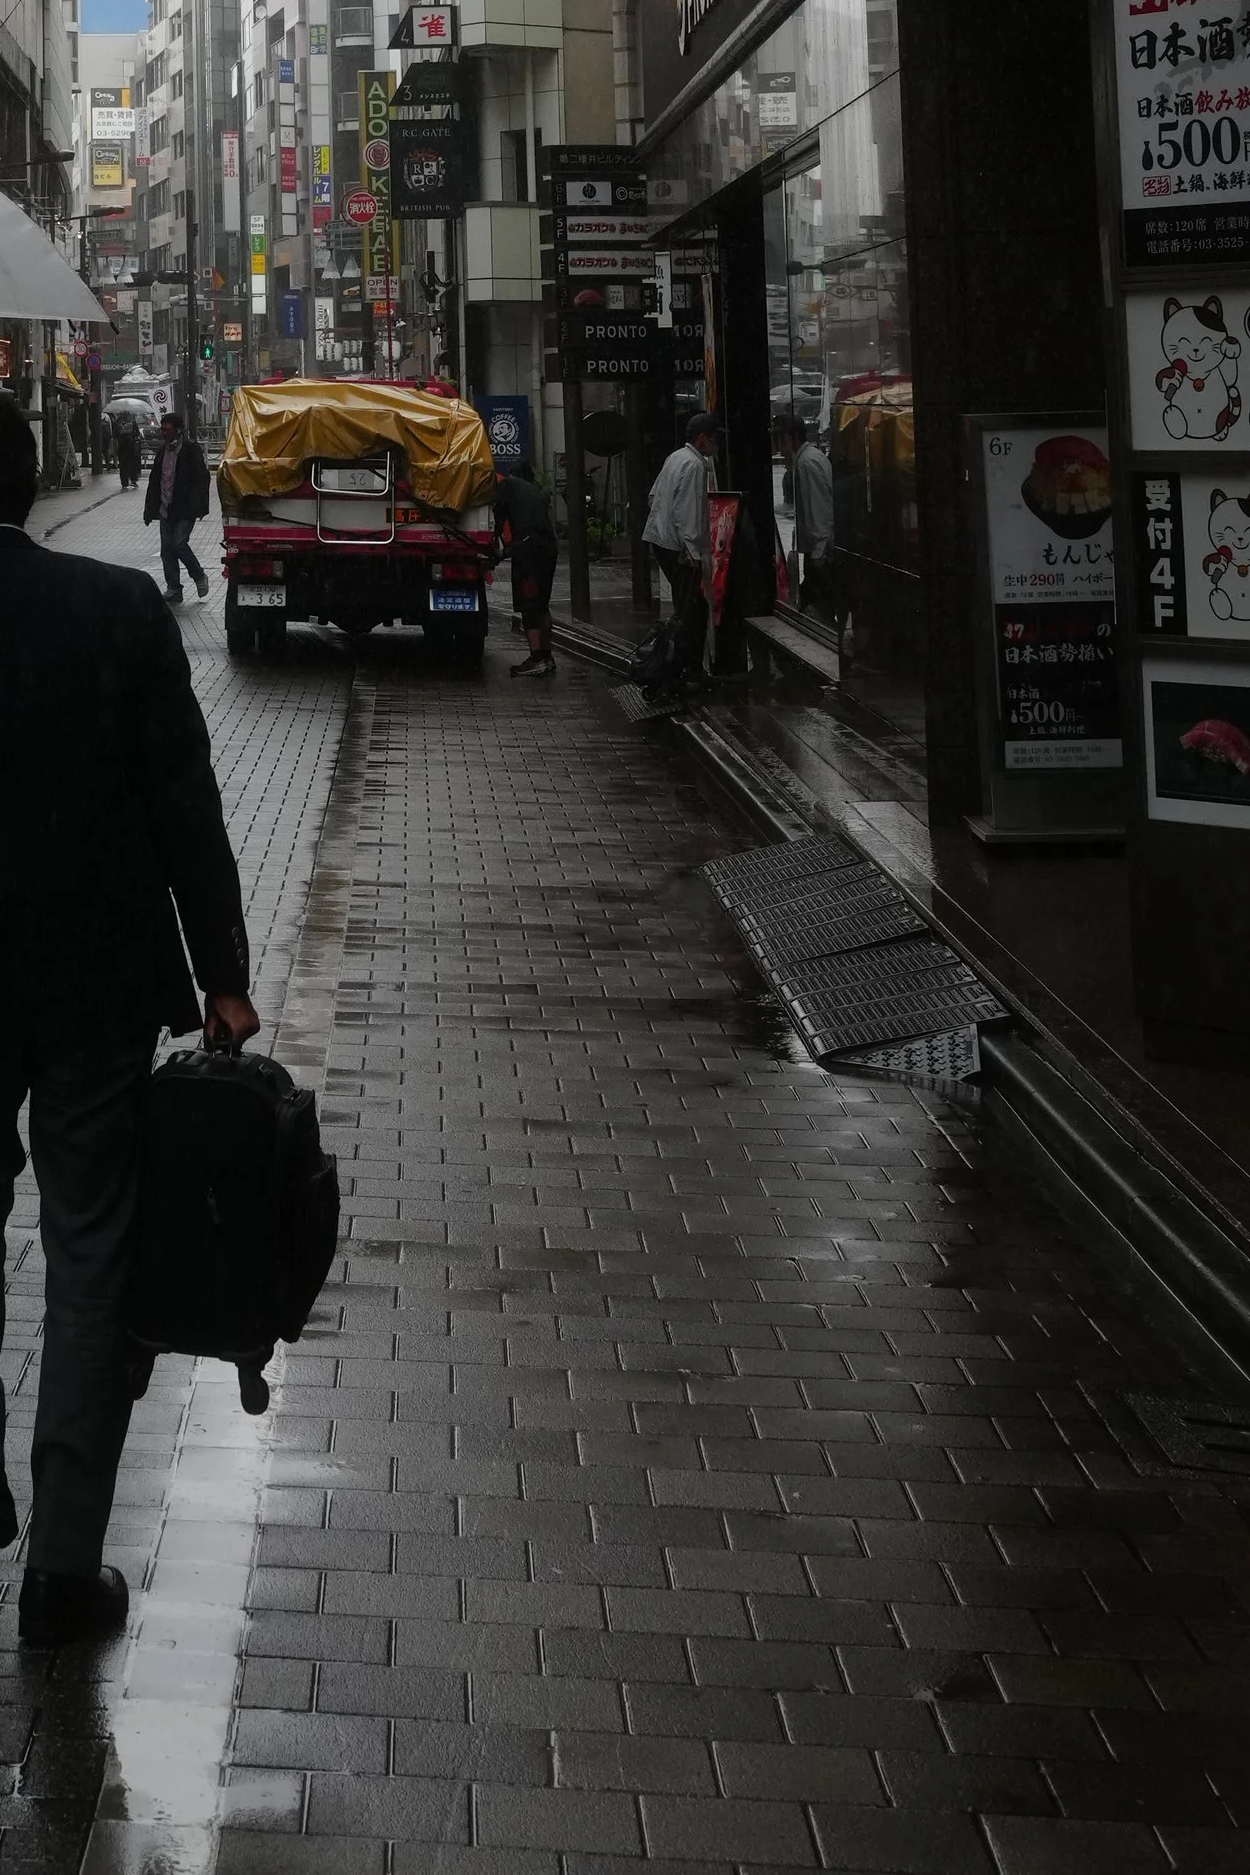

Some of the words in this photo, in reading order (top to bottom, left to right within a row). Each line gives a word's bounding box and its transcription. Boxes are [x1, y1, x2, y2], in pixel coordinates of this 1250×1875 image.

[417, 14, 447, 38] 雀
[400, 28, 410, 44] 4
[403, 84, 412, 101] 3
[422, 126, 451, 138] GATE
[1173, 170, 1250, 194] 土鍋、海鮮
[349, 201, 375, 214] 消火栓
[575, 222, 610, 233] カラオケ
[576, 257, 612, 268] カラオケ
[585, 325, 647, 339] PRONTO
[587, 360, 649, 373] PRONTO
[491, 413, 517, 424] COFFEE
[490, 443, 521, 455] BOSS
[989, 437, 1013, 456] 6F
[1143, 479, 1177, 628] 受付4F
[1097, 623, 1112, 637] の
[1004, 642, 1115, 665] 日本酒勢揃い
